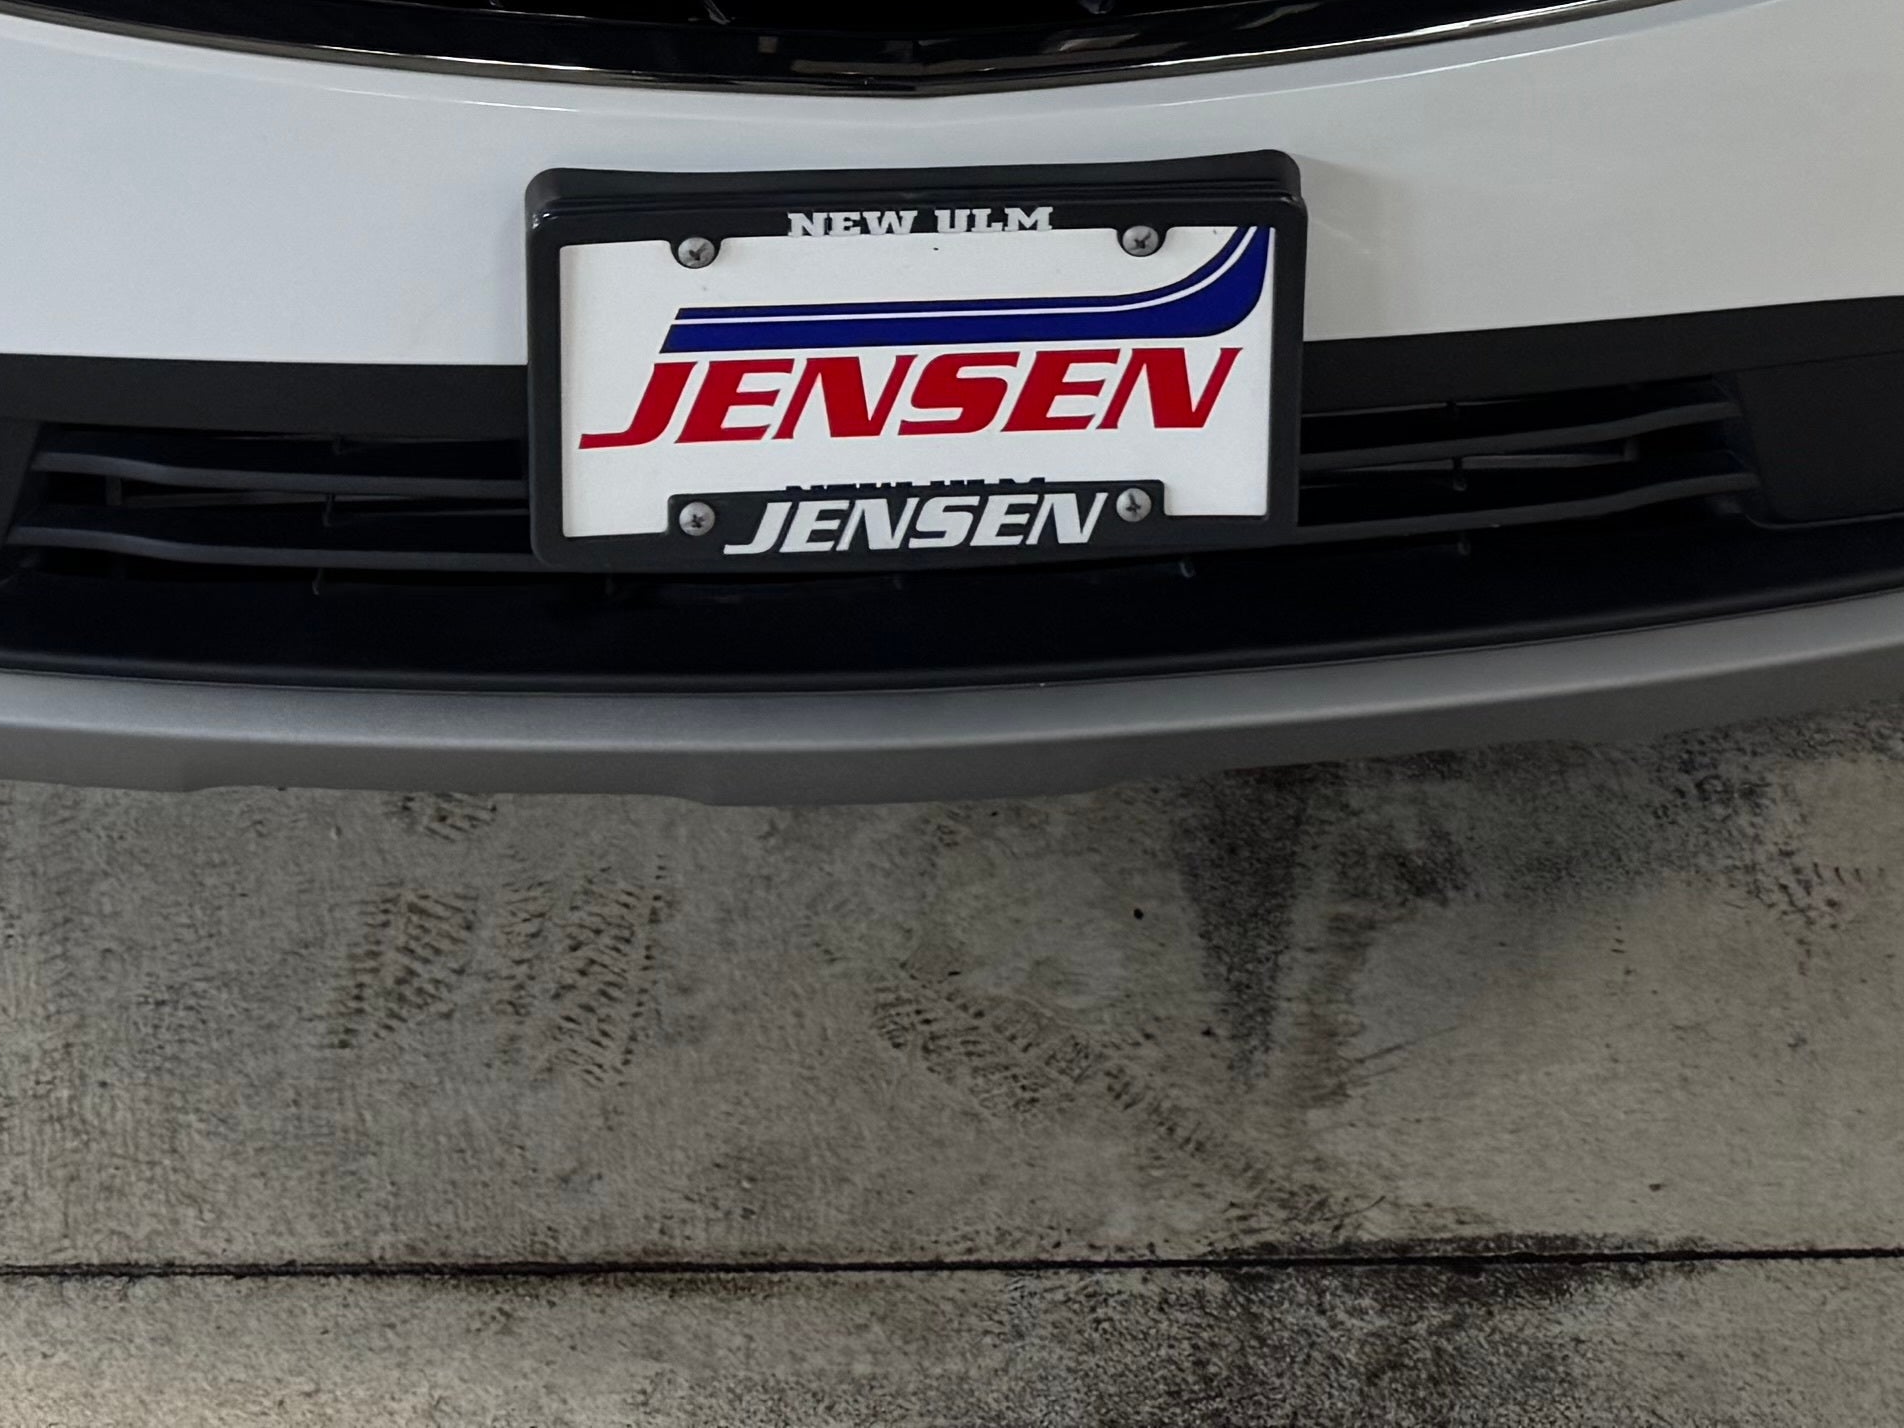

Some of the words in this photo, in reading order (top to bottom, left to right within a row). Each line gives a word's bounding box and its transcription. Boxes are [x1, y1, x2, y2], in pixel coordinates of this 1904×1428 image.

[787, 210, 918, 237] NEW
[934, 206, 1054, 233] ULM
[578, 346, 1243, 449] JENSEN
[723, 492, 1108, 555] JENSEN
